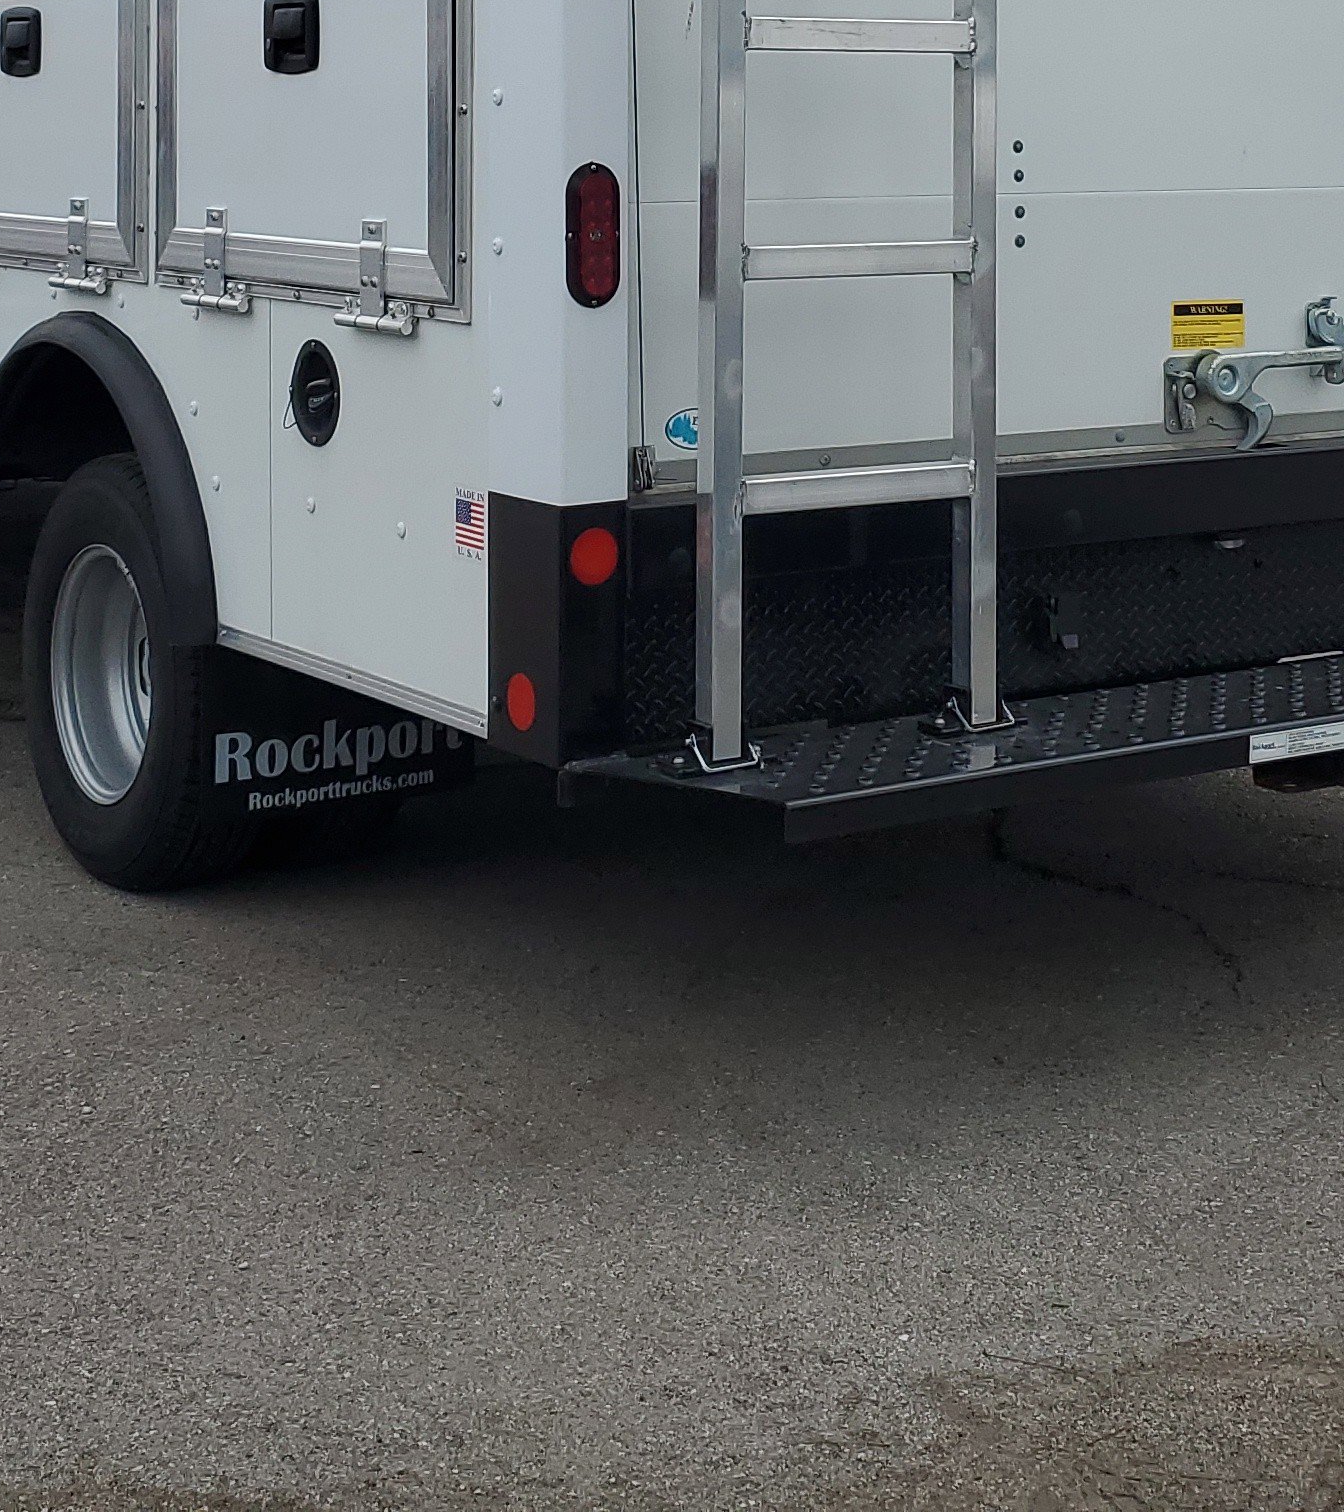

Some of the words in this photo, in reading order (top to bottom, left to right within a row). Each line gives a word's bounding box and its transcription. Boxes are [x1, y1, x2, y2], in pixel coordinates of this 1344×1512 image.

[455, 487, 476, 500] MADE
[476, 492, 485, 502] IN
[248, 769, 435, 810] Rockporttrucks.com
